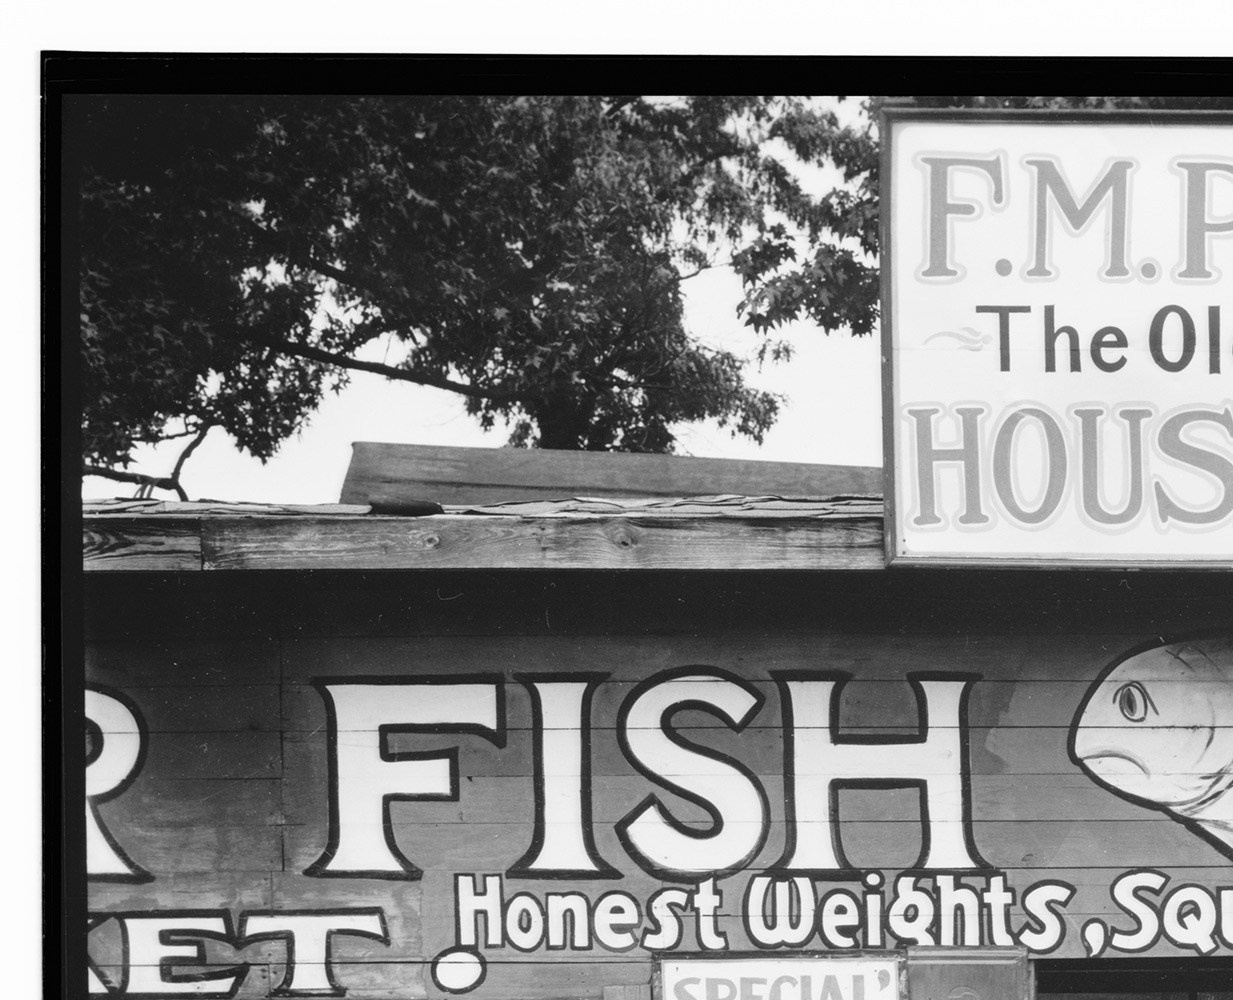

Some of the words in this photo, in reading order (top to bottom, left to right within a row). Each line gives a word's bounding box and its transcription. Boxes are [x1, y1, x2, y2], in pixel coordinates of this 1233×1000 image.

[916, 151, 1160, 283] F.M.
[975, 303, 1129, 374] The
[302, 665, 983, 882] FISH
[453, 872, 733, 952] Honest
